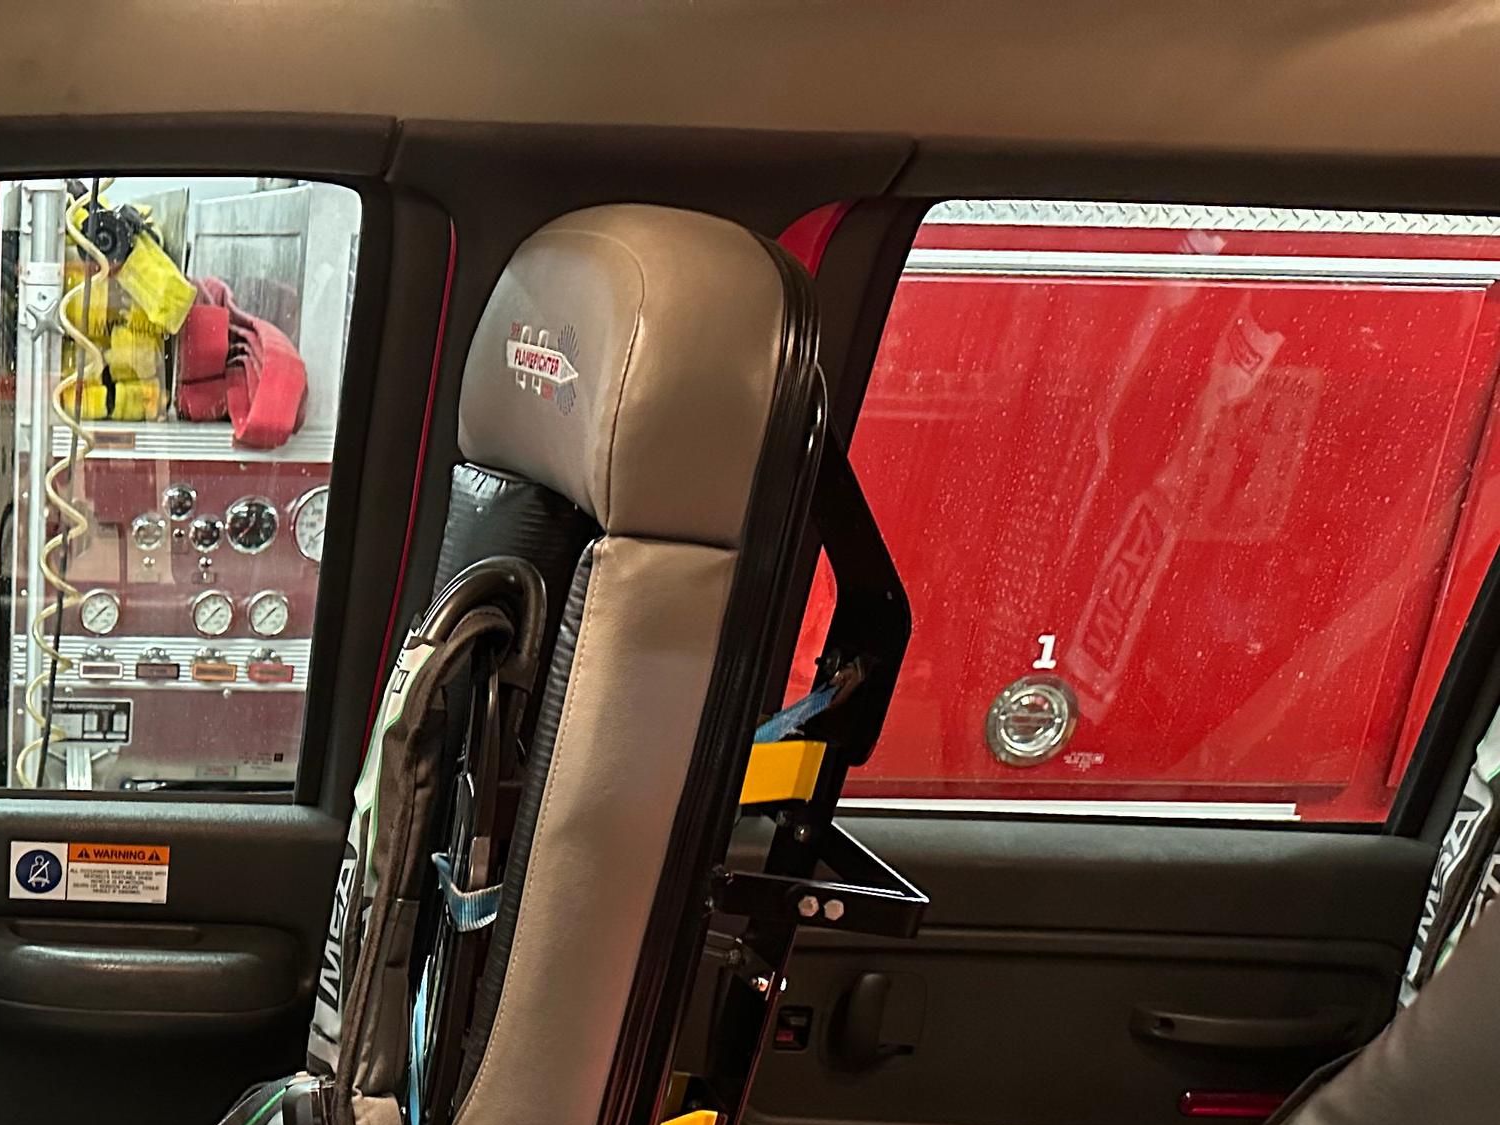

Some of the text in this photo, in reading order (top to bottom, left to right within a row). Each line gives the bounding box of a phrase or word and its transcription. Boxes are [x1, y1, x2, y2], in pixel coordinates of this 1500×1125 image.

[1032, 634, 1057, 669] 1
[93, 850, 146, 861] WARNING
[318, 860, 356, 1013] MSA
